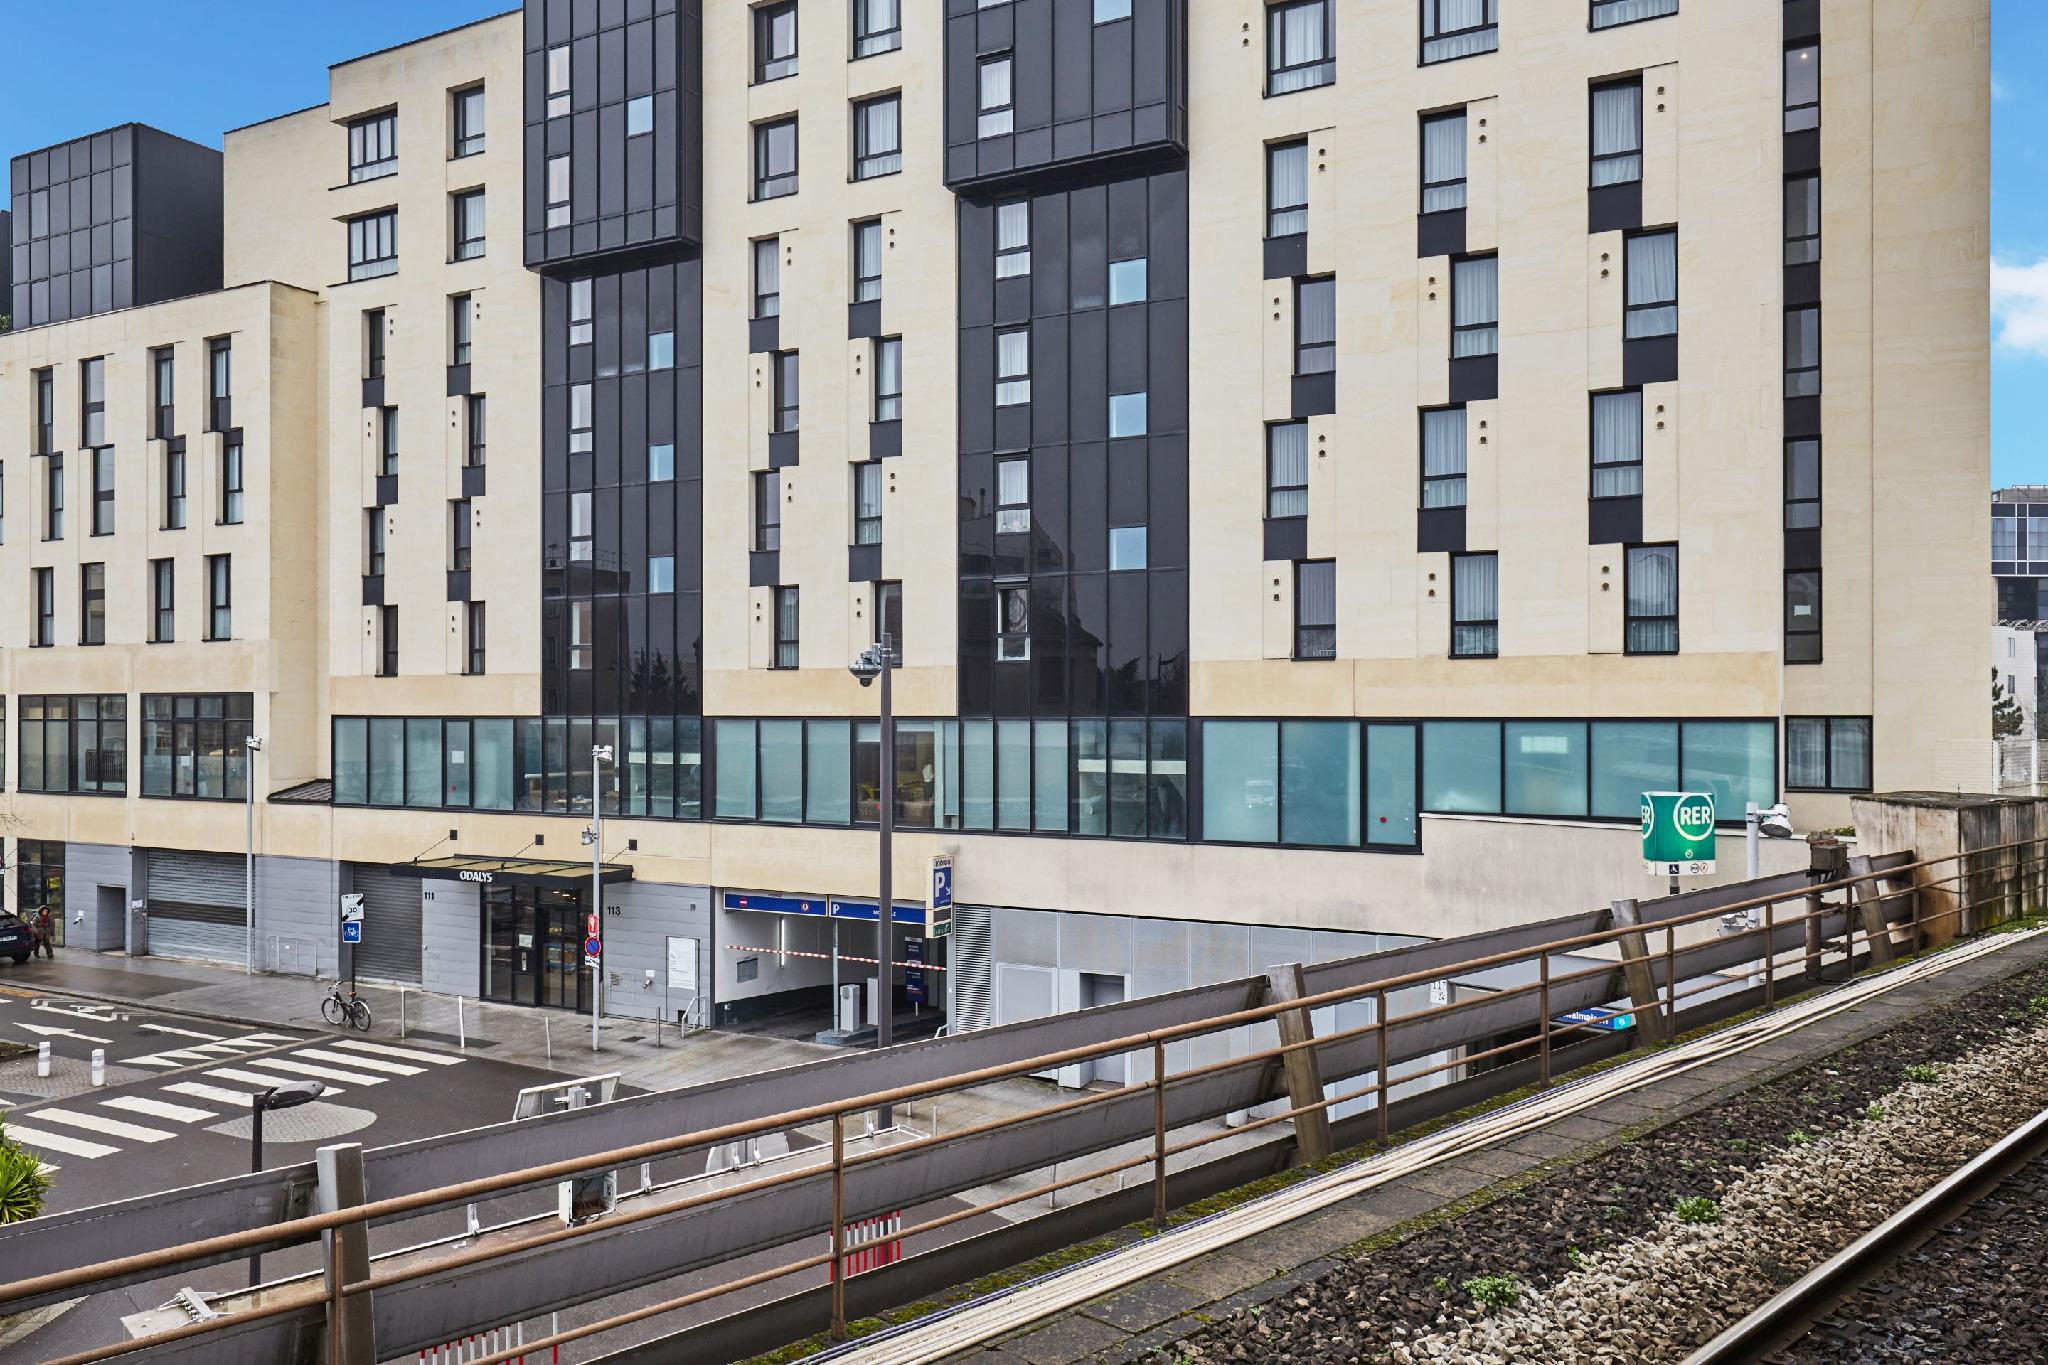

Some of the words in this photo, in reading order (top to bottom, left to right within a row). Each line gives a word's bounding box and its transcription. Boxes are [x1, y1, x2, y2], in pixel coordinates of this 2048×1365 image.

[1641, 805, 1651, 824] ER
[1680, 806, 1711, 825] RER
[460, 871, 493, 883] ODALYS
[935, 871, 945, 898] P
[424, 892, 435, 900] 111
[607, 905, 621, 916] 113
[833, 904, 840, 915] P
